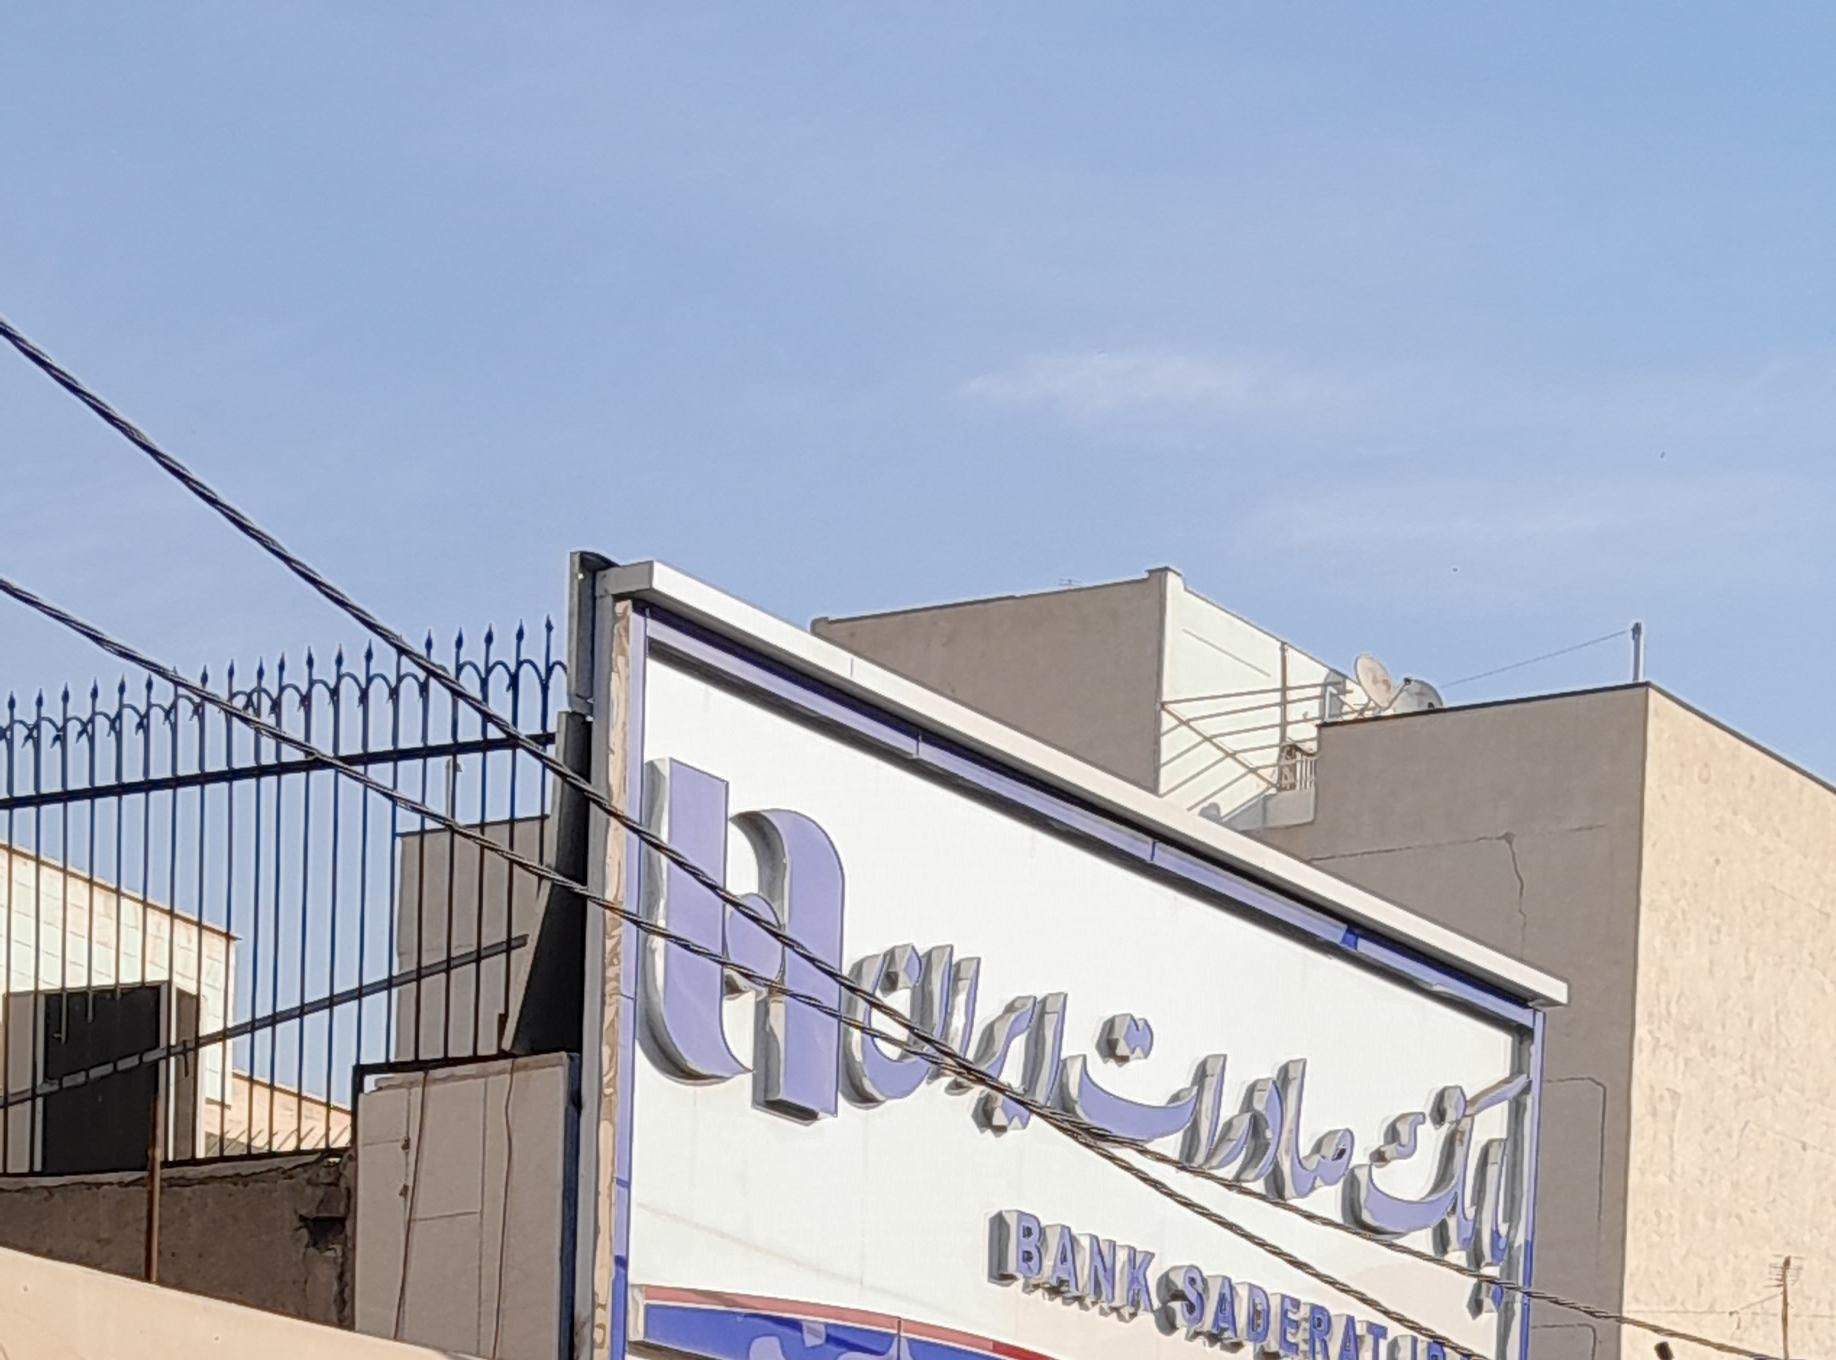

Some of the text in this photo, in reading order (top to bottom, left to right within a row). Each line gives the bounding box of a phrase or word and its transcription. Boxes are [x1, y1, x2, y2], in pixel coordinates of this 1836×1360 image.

[842, 944, 1532, 1318] بانک صادرات ایران
[990, 1210, 1155, 1320] BANK
